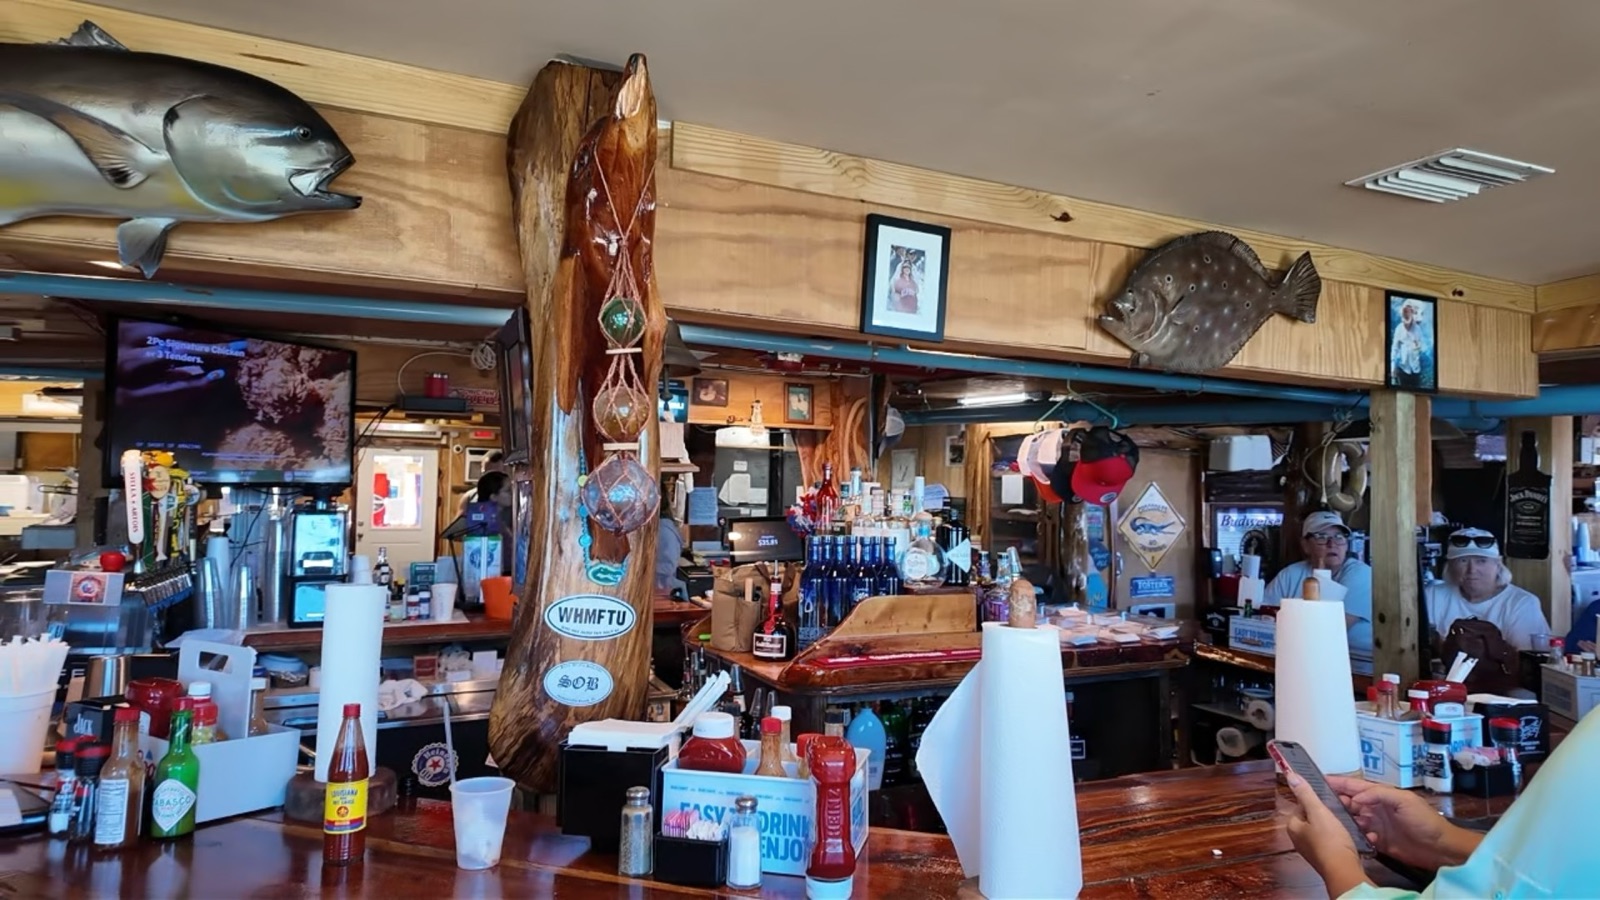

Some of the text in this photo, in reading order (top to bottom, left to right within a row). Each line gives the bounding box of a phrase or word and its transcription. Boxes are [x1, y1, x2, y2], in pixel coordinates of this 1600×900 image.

[211, 345, 246, 358] Chicken
[129, 471, 137, 499] STELLA
[1221, 514, 1282, 529] Budweise
[558, 606, 627, 626] WHMFTU
[557, 675, 599, 691] SOB
[154, 795, 192, 807] ABASCO
[827, 786, 841, 836] HEINZ
[761, 836, 810, 863] ENJO
